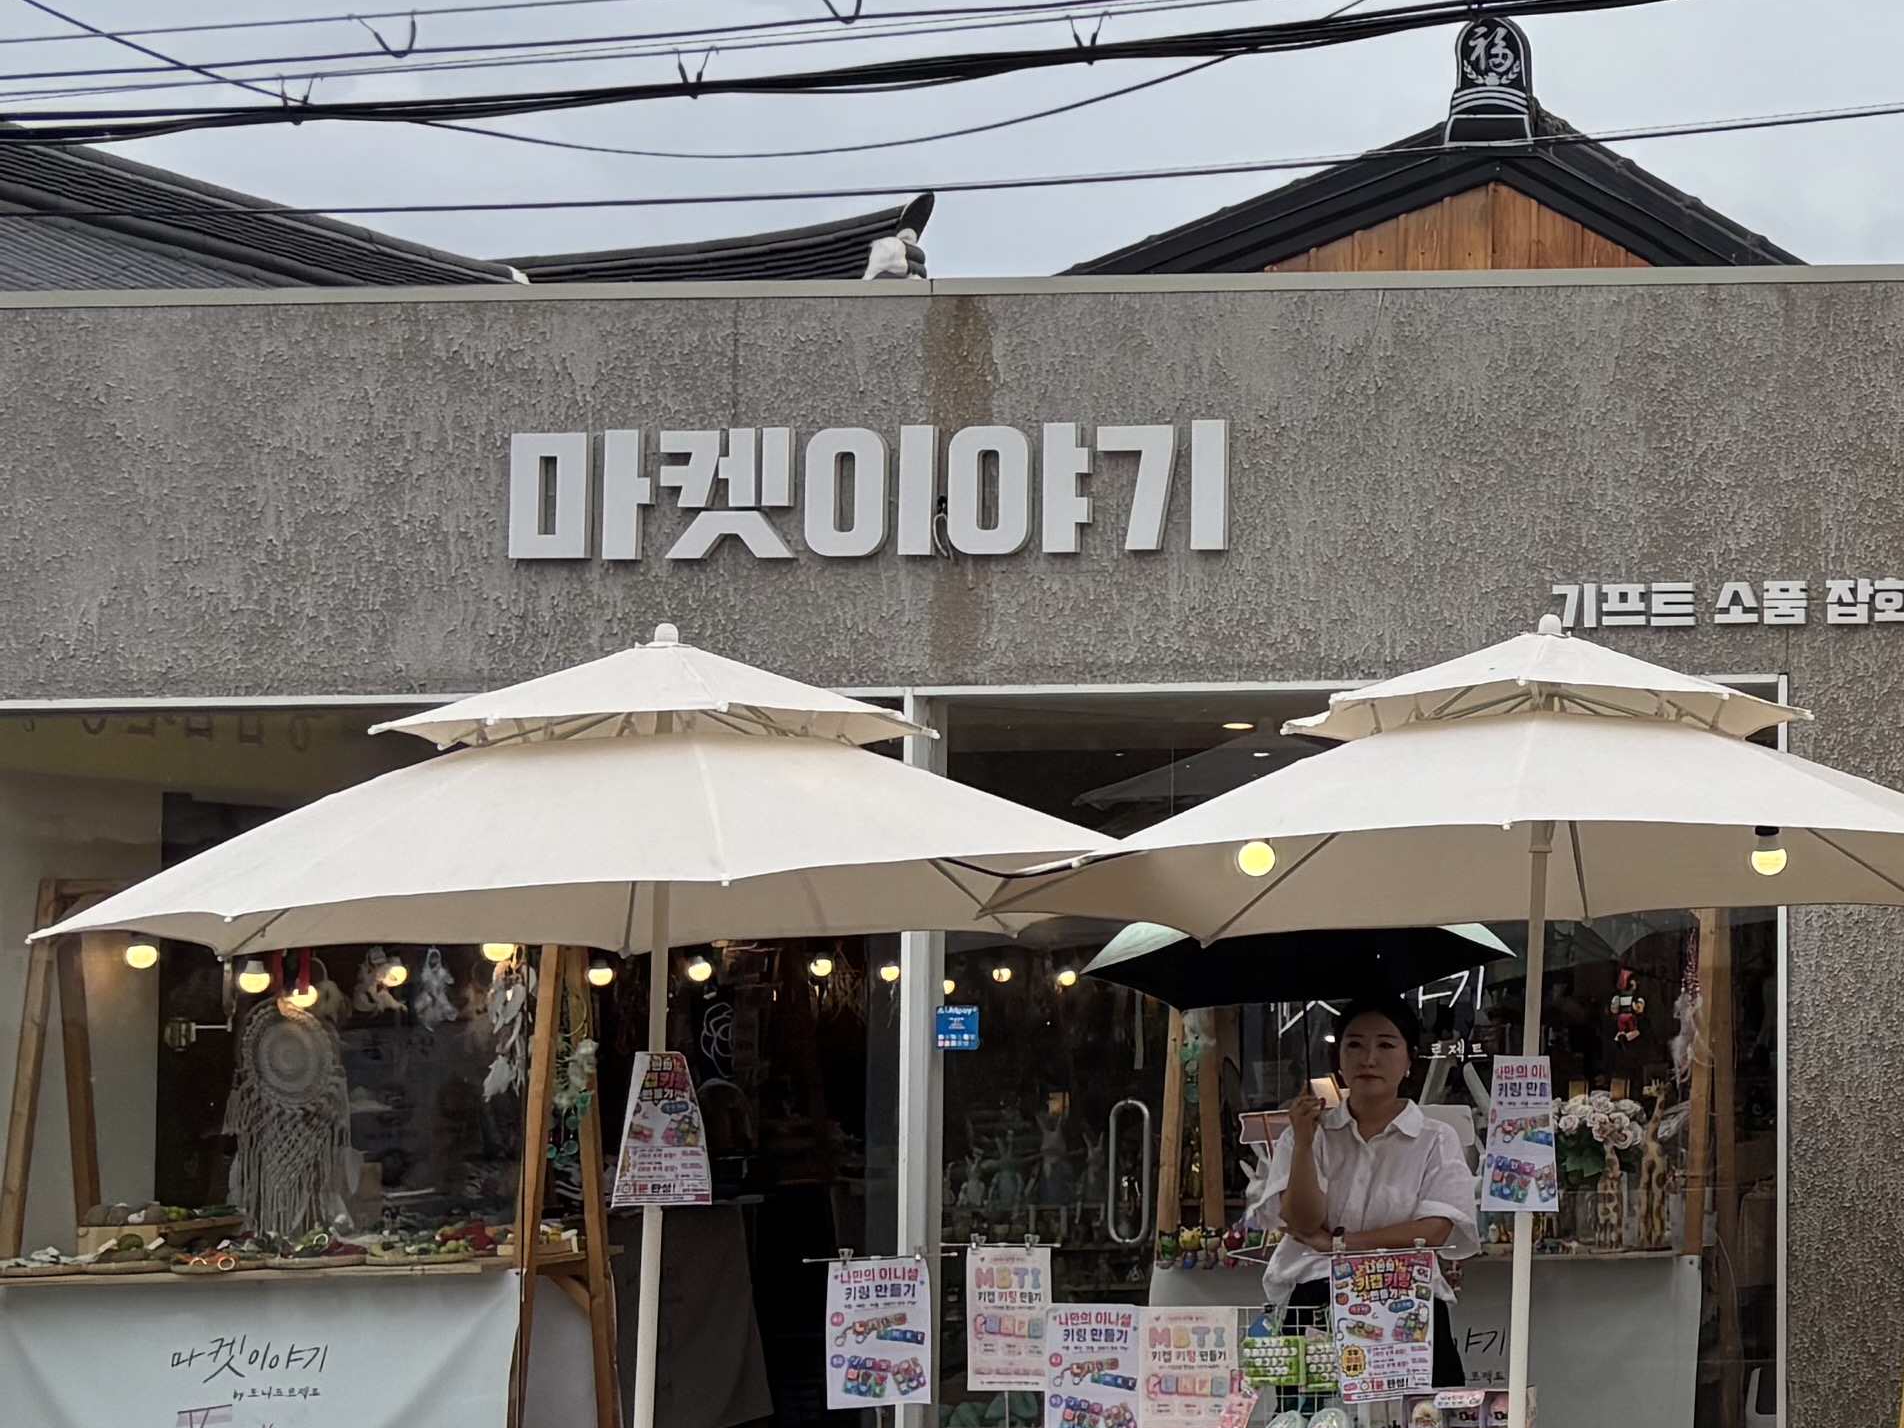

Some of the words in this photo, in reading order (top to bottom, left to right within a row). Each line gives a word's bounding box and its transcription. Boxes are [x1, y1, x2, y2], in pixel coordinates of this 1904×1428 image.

[506, 418, 1230, 561] 마켓이야기
[1551, 581, 1698, 629] 기프트
[1713, 579, 1809, 625] 소품
[974, 1265, 1042, 1290] MBTI
[171, 1334, 328, 1384] 마켓이야기
[1148, 1325, 1227, 1350] MBTI
